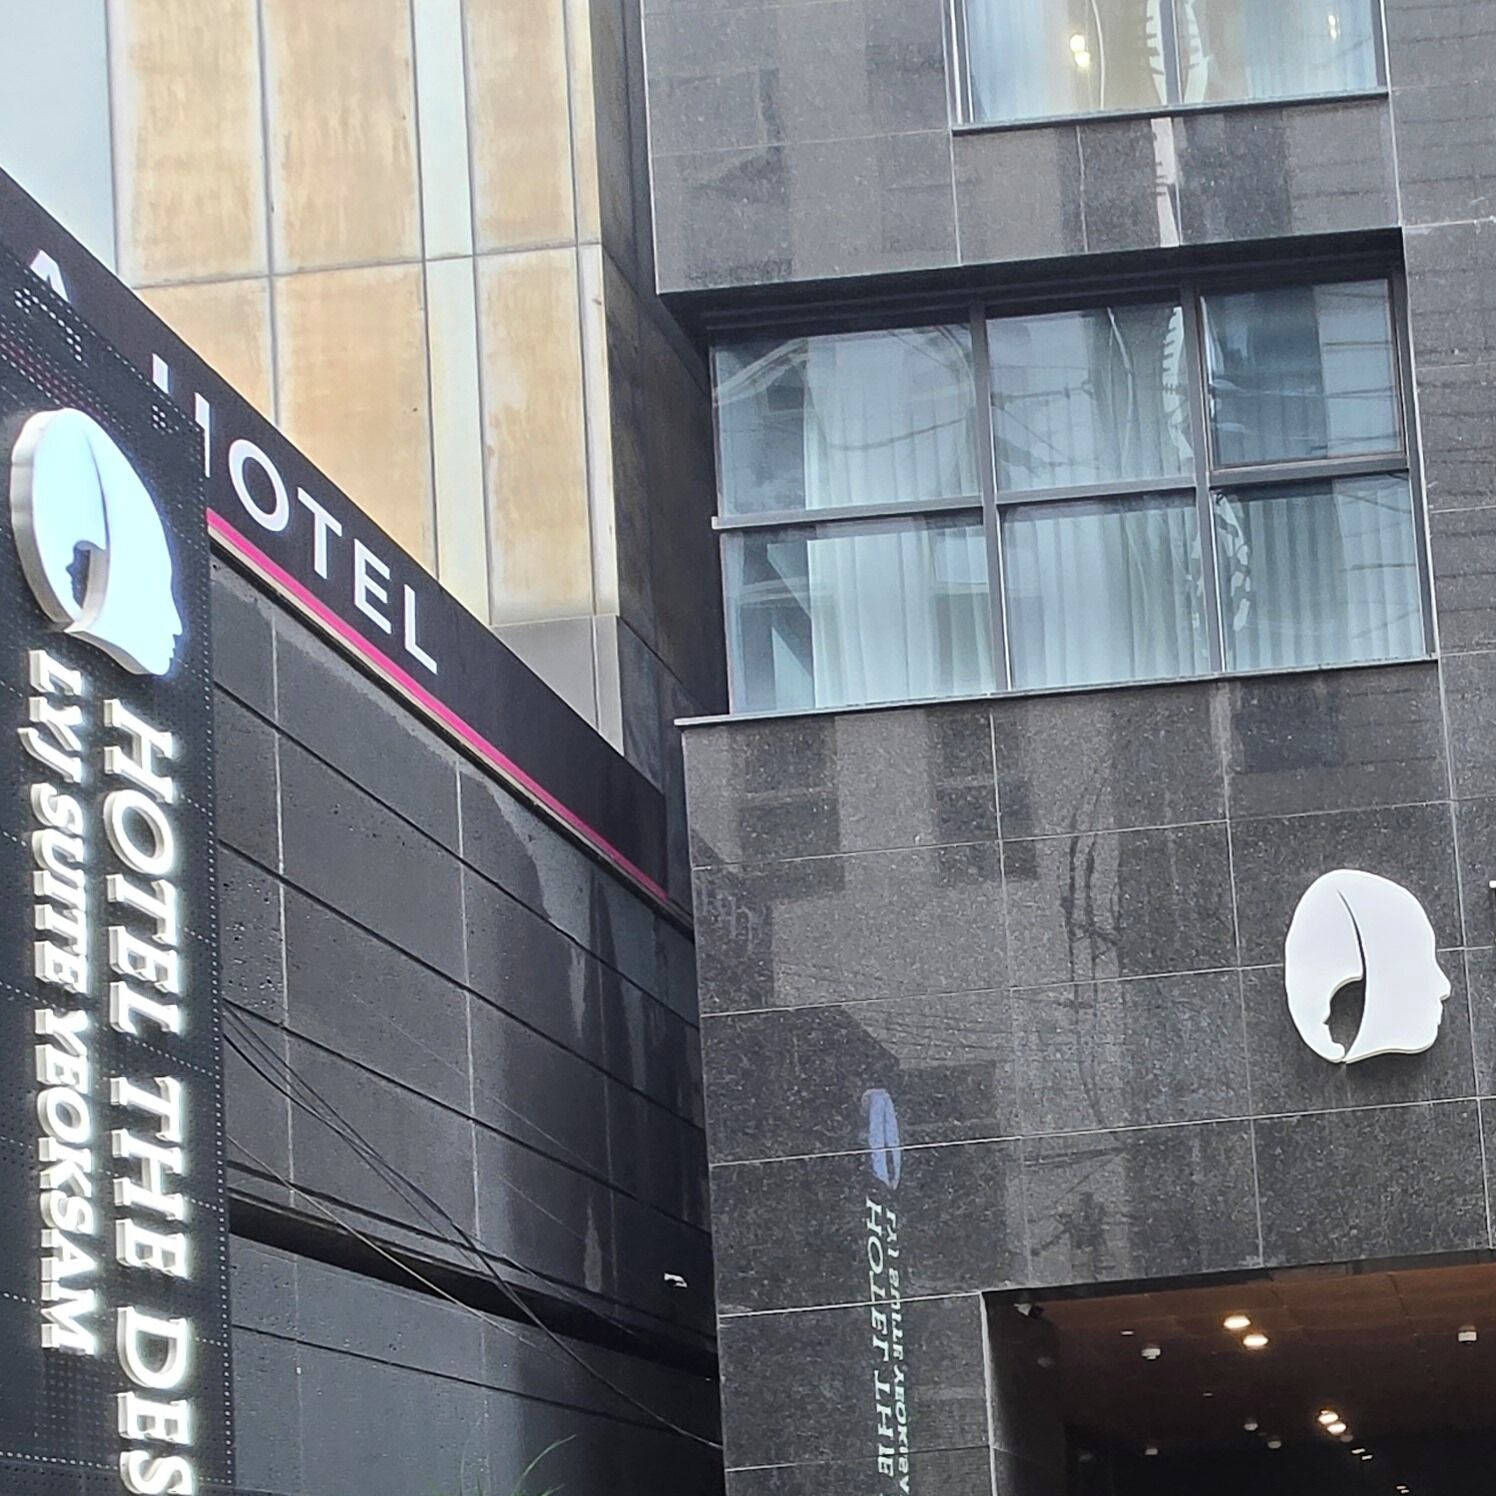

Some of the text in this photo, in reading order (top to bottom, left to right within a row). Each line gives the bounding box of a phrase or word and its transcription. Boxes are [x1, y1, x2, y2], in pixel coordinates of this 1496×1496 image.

[17, 650, 99, 1355] LYJ SUITE YEOKSAM
[103, 697, 180, 1037] HOTEL
[110, 1075, 190, 1279] THE
